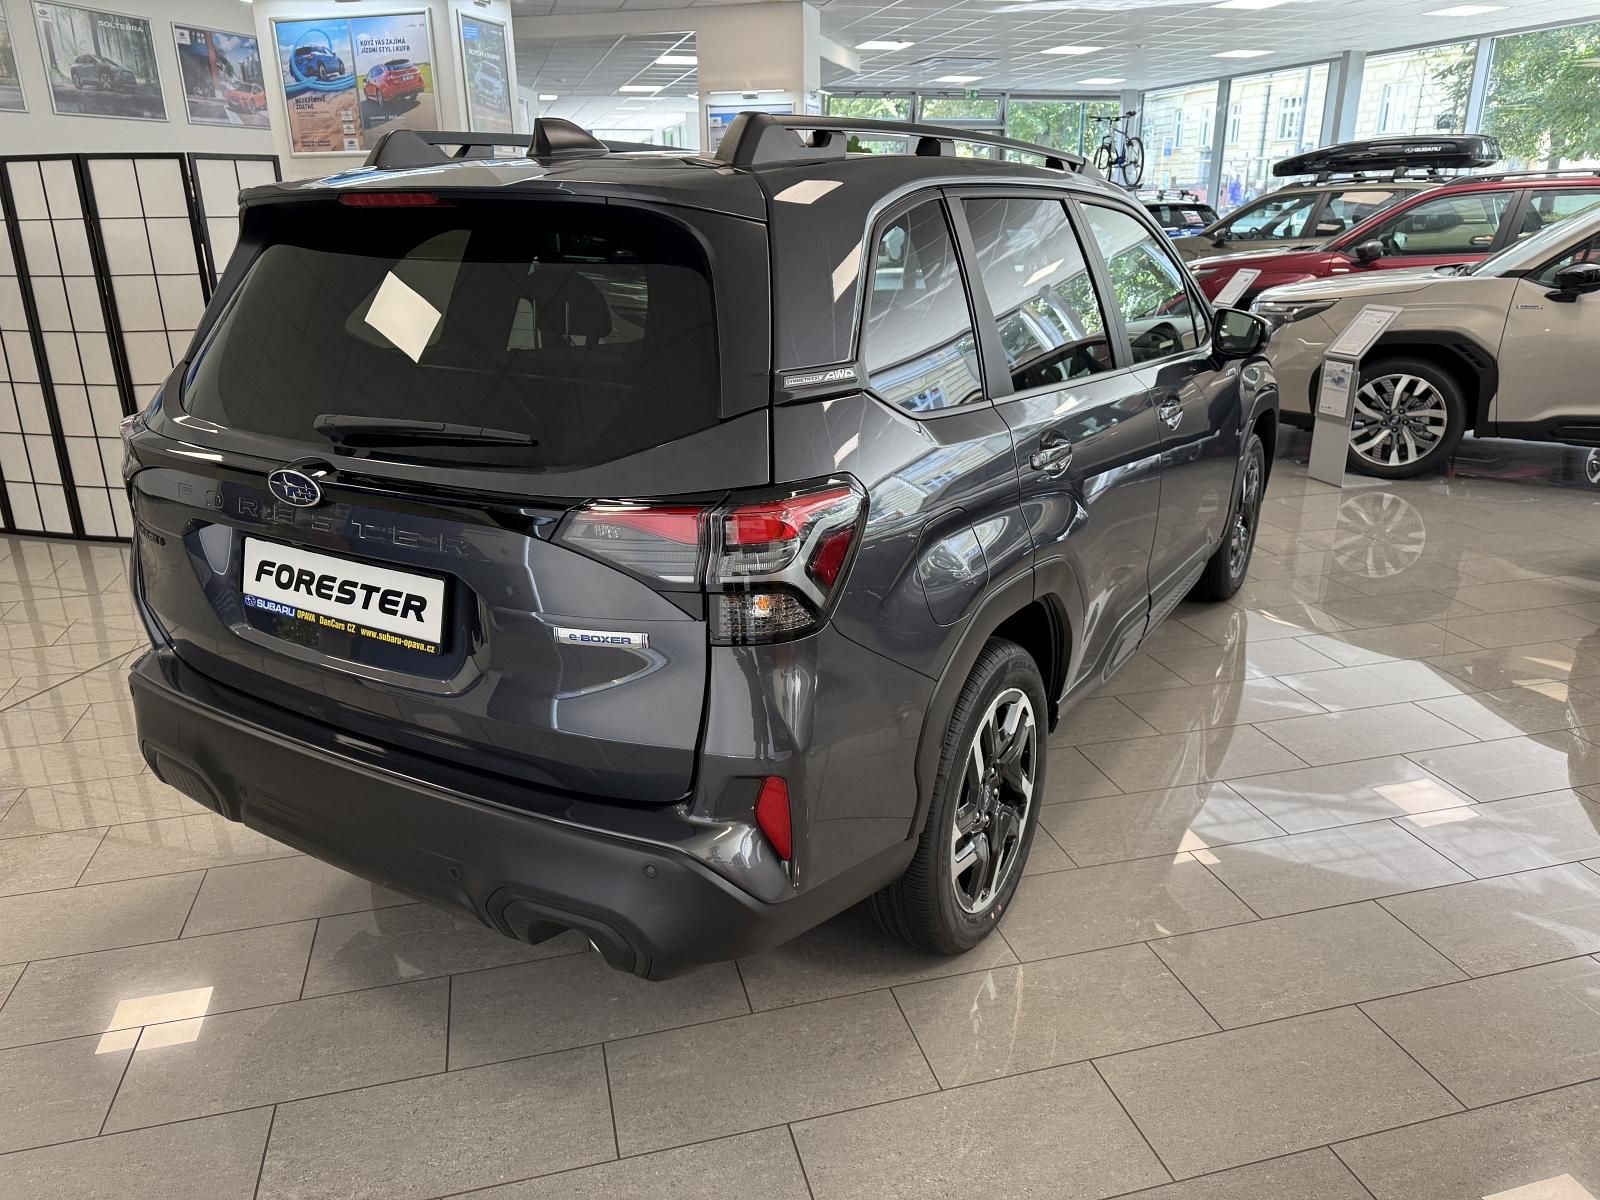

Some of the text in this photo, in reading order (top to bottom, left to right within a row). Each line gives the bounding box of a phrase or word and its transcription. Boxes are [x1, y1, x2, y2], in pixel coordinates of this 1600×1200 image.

[97, 20, 144, 33] SOLTERRA
[824, 367, 856, 381] AWD
[254, 559, 428, 623] FORESTER
[256, 598, 436, 655] SUBARU OPAVA DanCars CZ www.subaru-opava.cz
[568, 633, 632, 645] e-BOXER
